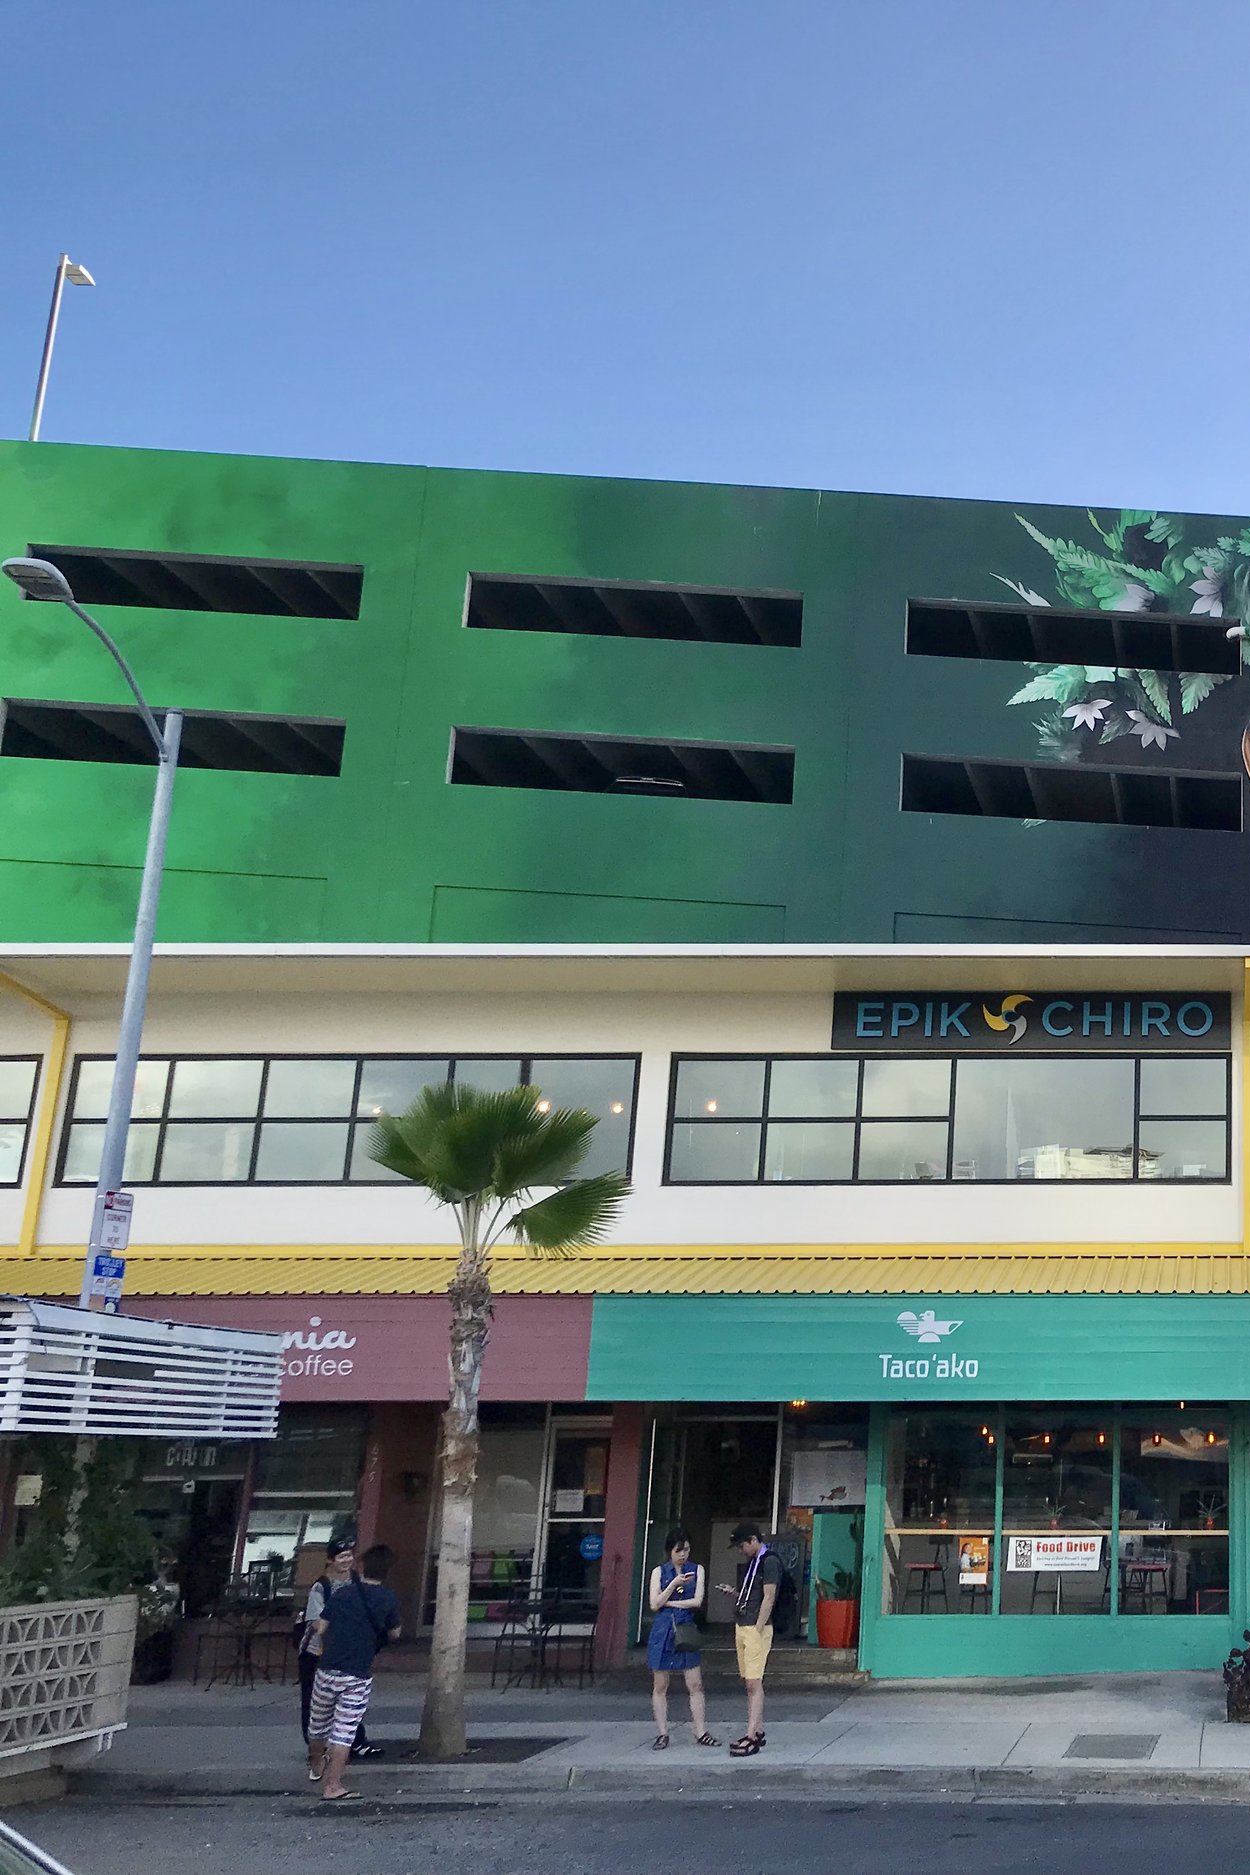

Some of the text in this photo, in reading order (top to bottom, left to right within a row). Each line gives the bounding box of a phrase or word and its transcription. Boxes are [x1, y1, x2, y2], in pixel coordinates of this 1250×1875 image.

[856, 1001, 1213, 1037] EPIK CHIRO
[1036, 1541, 1096, 1552] Food Drive
